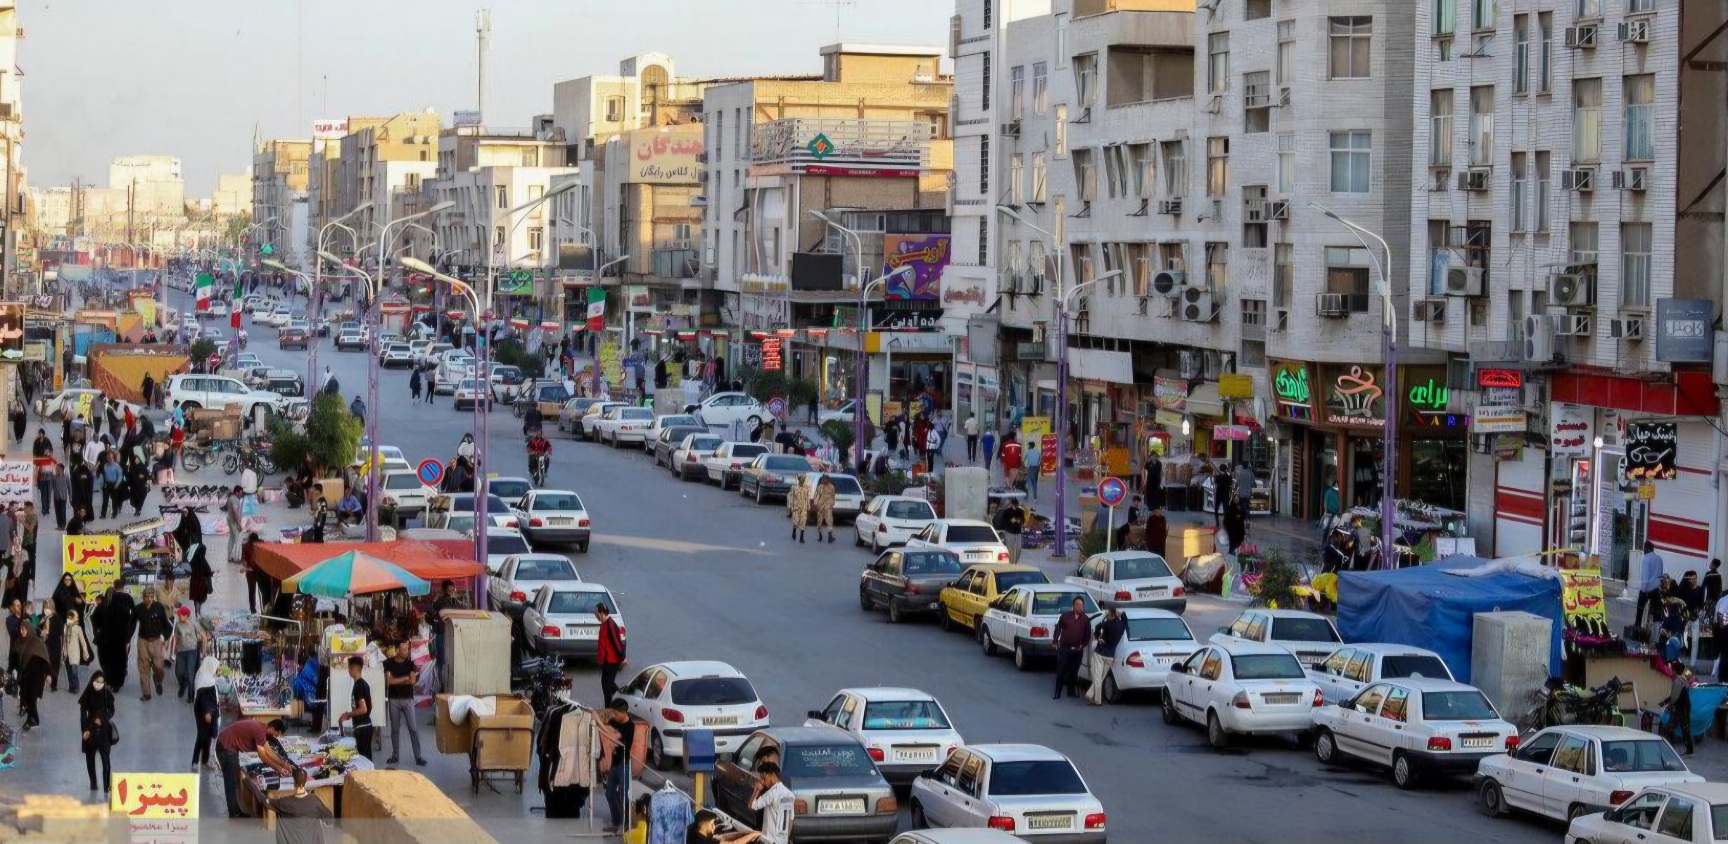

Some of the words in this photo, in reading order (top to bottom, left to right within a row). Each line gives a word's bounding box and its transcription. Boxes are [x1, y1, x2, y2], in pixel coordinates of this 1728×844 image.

[666, 167, 689, 179] کلاس
[67, 540, 116, 567] پیتزا
[117, 778, 189, 817] پیتزا
